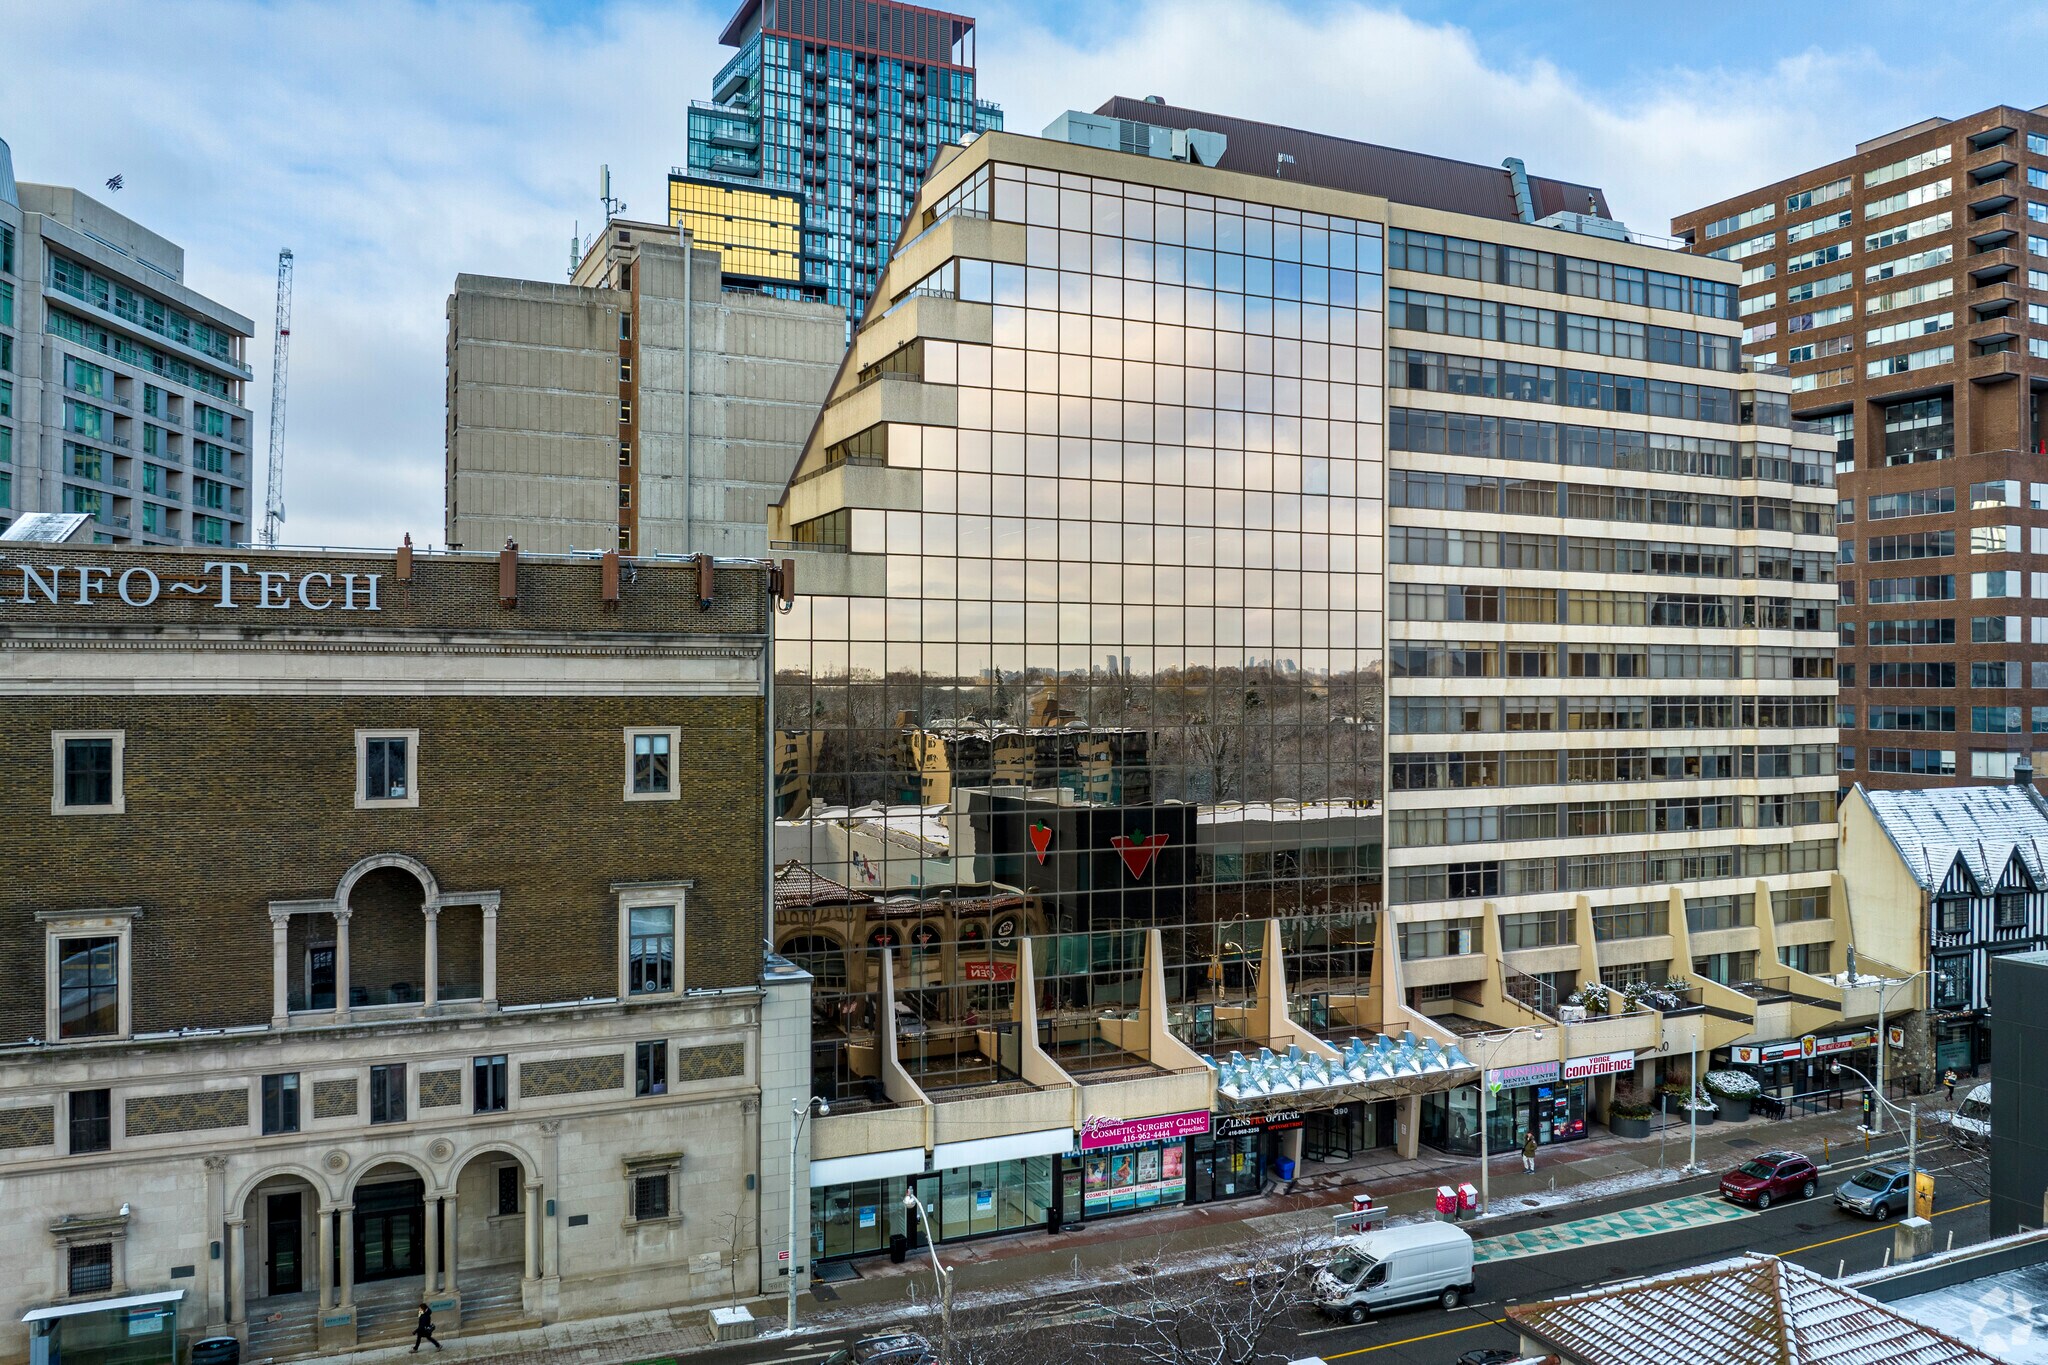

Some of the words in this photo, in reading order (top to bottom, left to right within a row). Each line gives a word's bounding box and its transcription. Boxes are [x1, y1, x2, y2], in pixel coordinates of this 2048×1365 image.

[1589, 1055, 1611, 1064] YONGE
[1503, 1063, 1558, 1079] ROSEDALE
[1565, 1058, 1633, 1078] CONVENIENCE
[1503, 1075, 1531, 1084] DENTAL
[1532, 1071, 1558, 1081] CENTRE
[1333, 1107, 1349, 1116] 890
[1091, 1125, 1136, 1139] COSMETIC
[1136, 1120, 1175, 1133] SURGERY
[1176, 1116, 1206, 1128] CLINIC
[1122, 1129, 1171, 1142] 416-962-4444
[1085, 1190, 1109, 1199] COSMETIC
[1112, 1187, 1134, 1195] SURGERY
